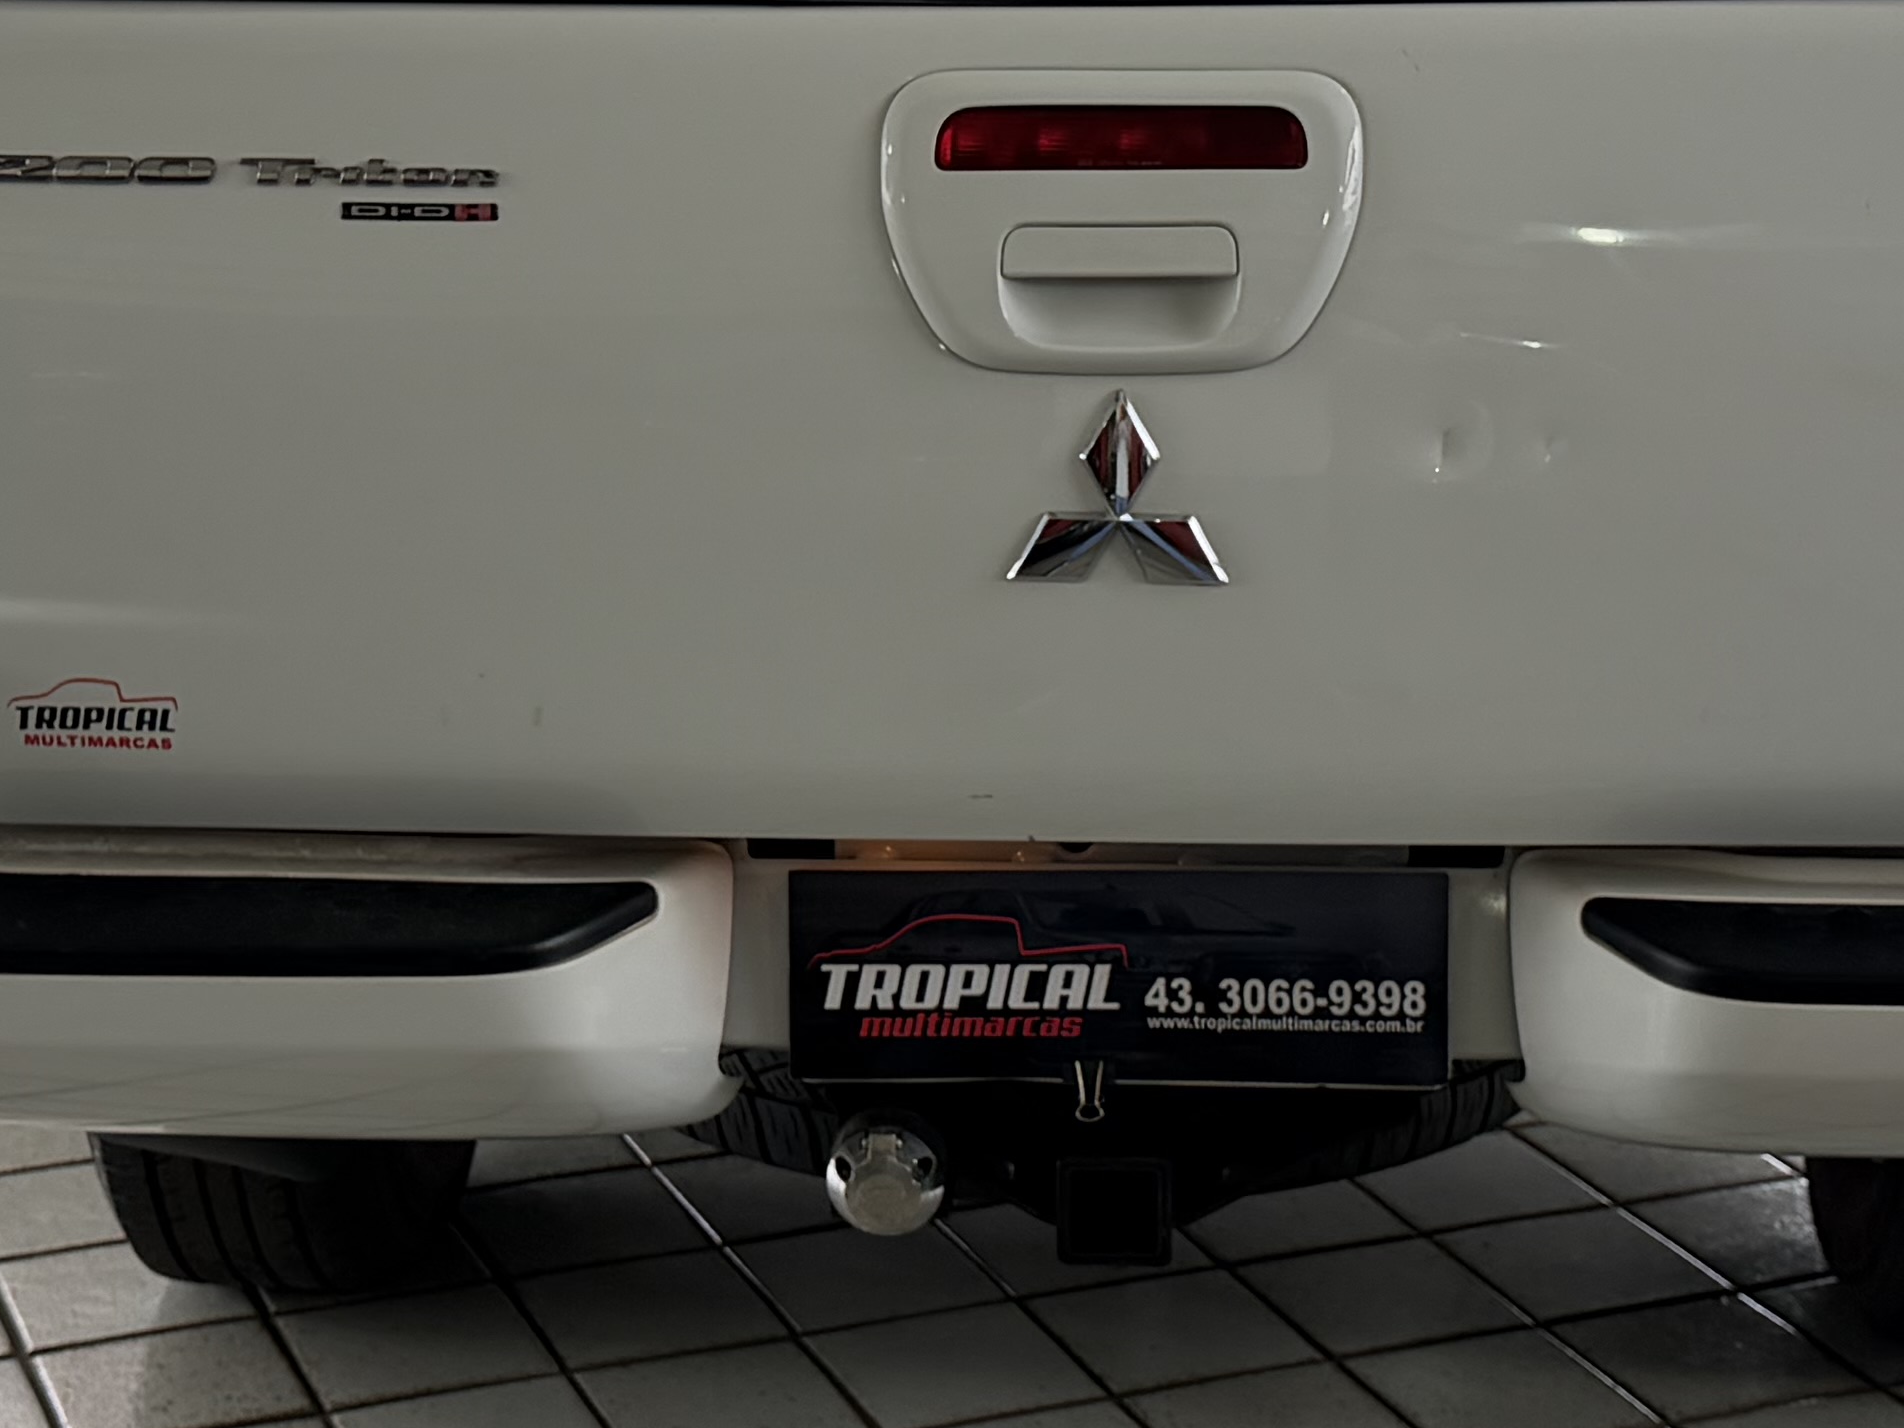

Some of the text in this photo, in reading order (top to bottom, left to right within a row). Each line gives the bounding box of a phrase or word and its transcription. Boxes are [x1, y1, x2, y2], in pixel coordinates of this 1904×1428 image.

[240, 157, 499, 186] Triton
[15, 705, 175, 733] TROPICAL
[23, 733, 173, 751] MULTIMARCAS
[820, 963, 1121, 1010] TROPICAL
[1144, 976, 1427, 1017] 43. 3066-9398
[858, 1012, 1084, 1038] multimarcas
[1146, 1014, 1426, 1033] www.tropicalmultimarcas.com.br
